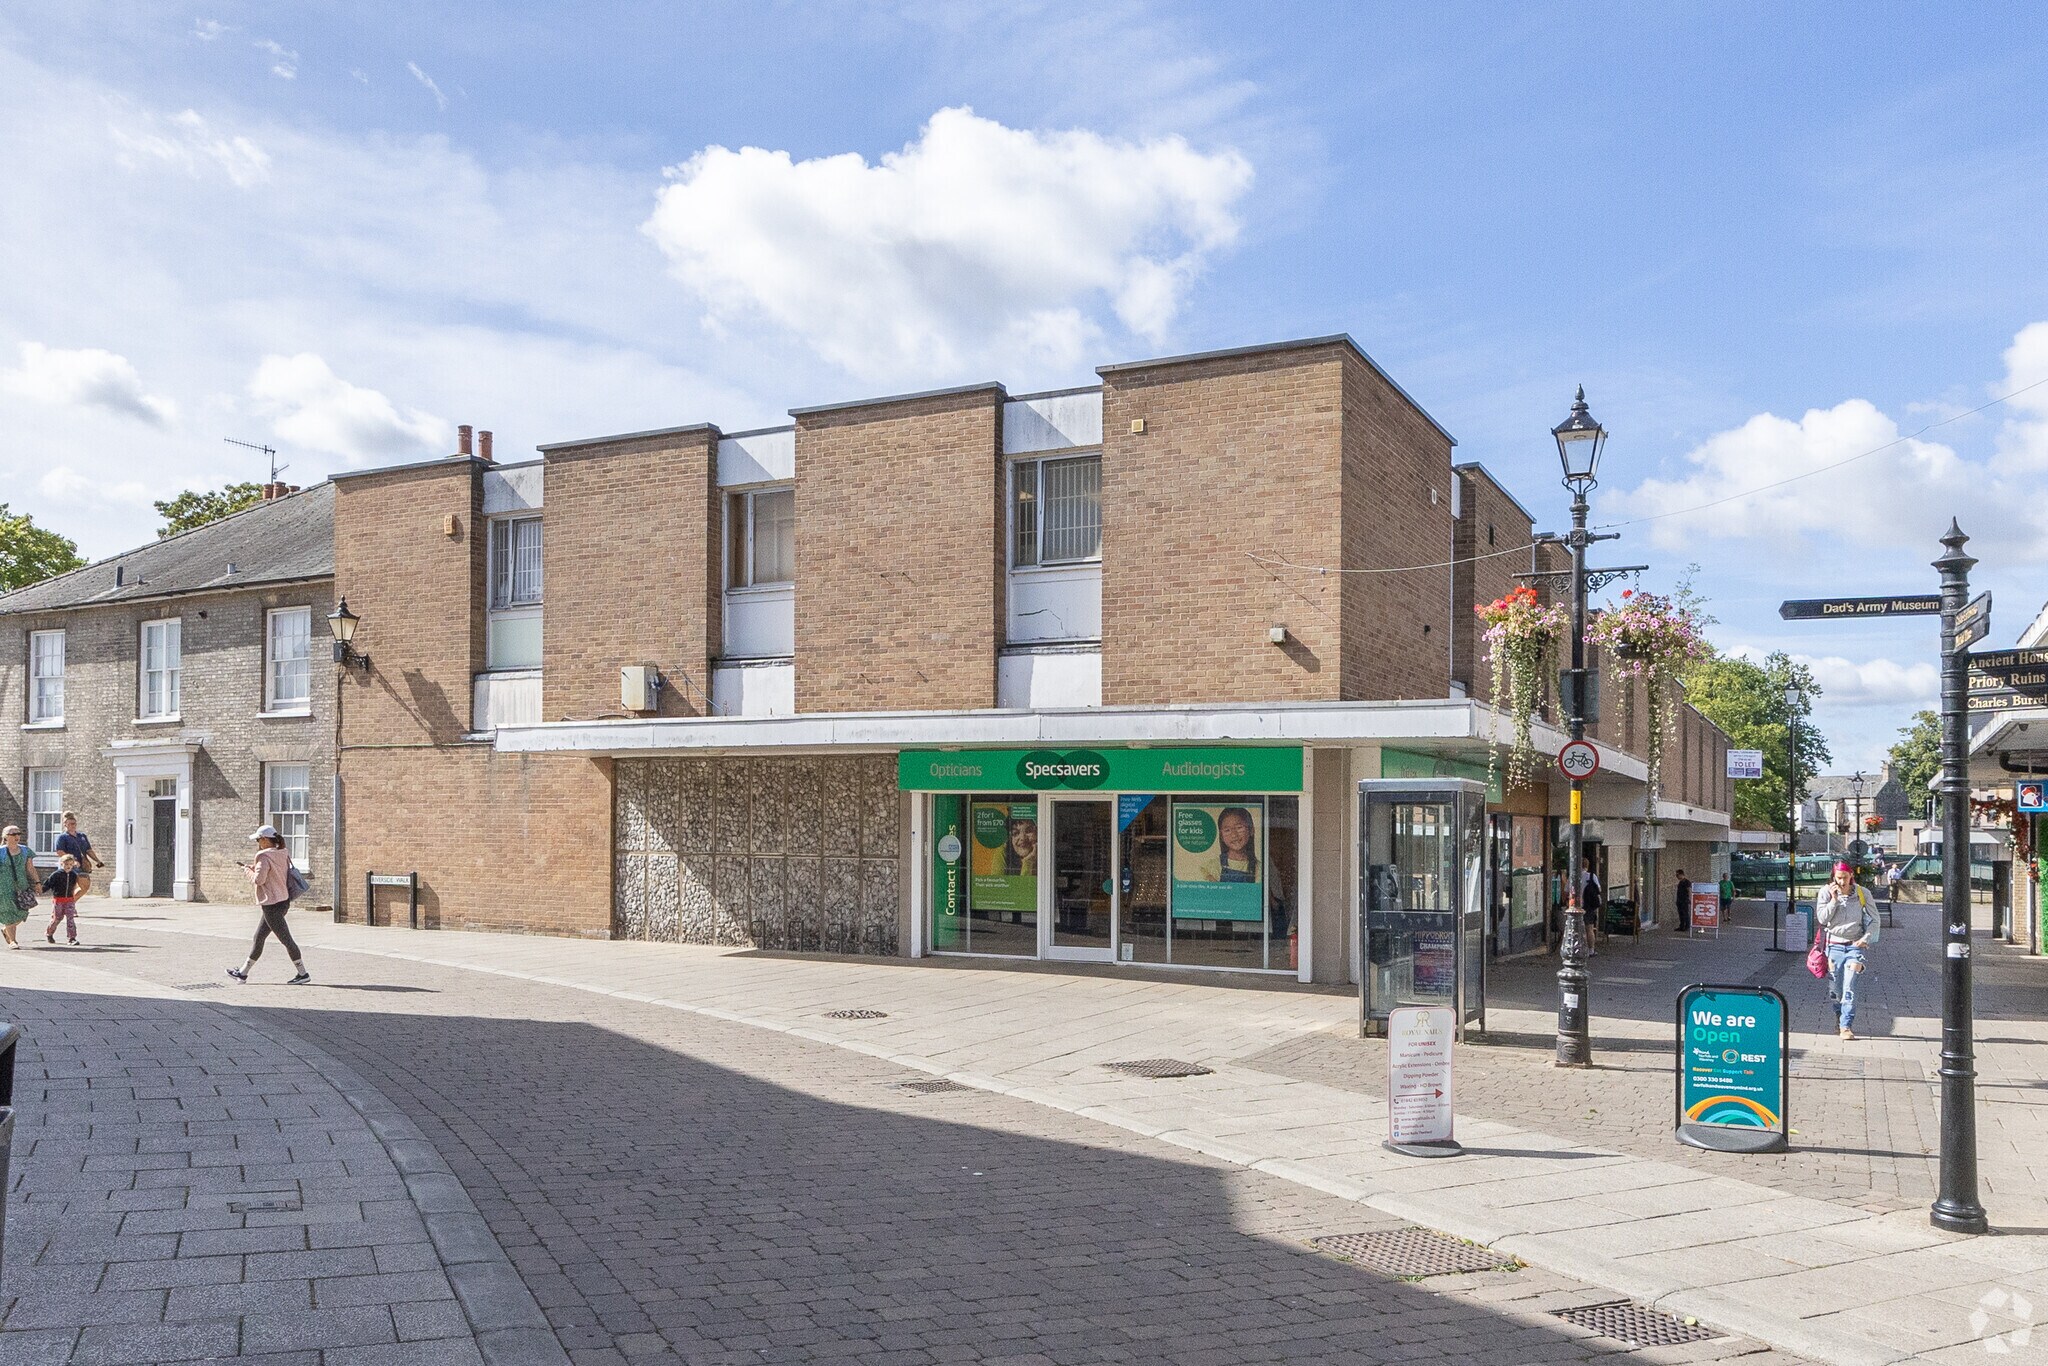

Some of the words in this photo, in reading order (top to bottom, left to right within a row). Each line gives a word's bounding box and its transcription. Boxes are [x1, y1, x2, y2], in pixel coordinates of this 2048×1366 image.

[1823, 602, 1854, 614] Dad's
[1856, 602, 1888, 613] Army
[1891, 600, 1939, 610] Museum
[1968, 654, 2015, 669] Ancient
[1968, 676, 2006, 688] Priory
[2010, 672, 2046, 686] Ruins
[1967, 696, 2008, 708] Charles
[930, 763, 982, 778] Opticians
[1026, 762, 1100, 779] Specsavers
[1162, 762, 1245, 779] Audiologists
[1573, 803, 1578, 811] 3
[1178, 819, 1202, 827] glasses
[946, 870, 956, 916] Contact
[1694, 903, 1716, 916] £3
[1692, 1011, 1722, 1026] We
[1726, 1015, 1756, 1028] are
[1693, 1028, 1740, 1045] Open
[1741, 1054, 1766, 1063] REST
